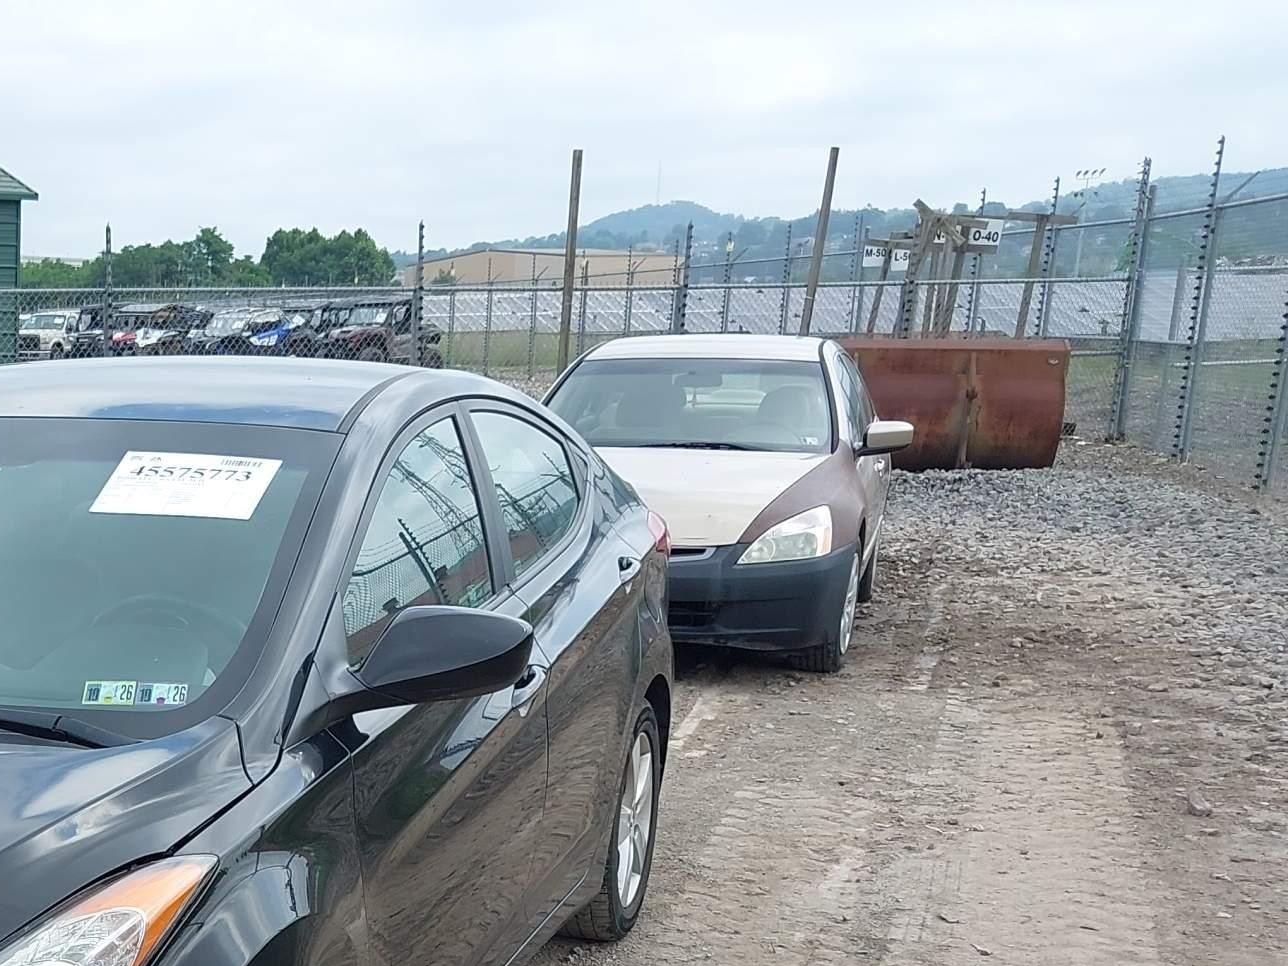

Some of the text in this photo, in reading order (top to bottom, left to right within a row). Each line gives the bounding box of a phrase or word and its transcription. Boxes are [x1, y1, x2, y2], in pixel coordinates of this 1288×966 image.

[973, 230, 999, 243] O-40
[865, 248, 887, 258] M-50
[894, 252, 911, 262] L-5
[130, 465, 252, 482] 45575773
